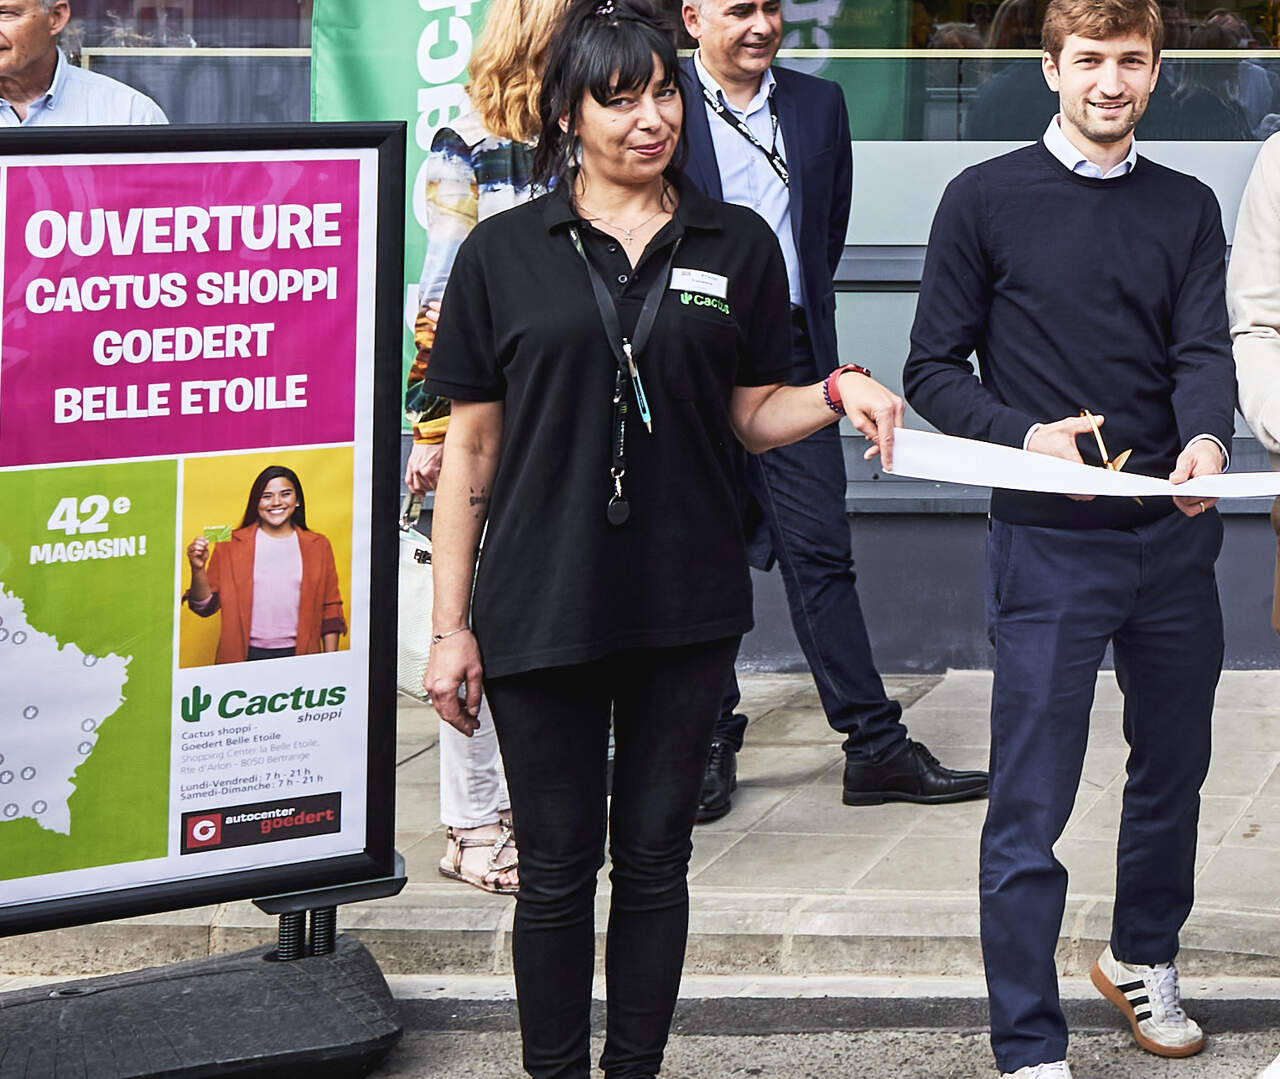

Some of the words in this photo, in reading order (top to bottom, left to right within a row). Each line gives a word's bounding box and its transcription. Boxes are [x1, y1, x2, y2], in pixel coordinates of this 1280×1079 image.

[24, 203, 342, 258] OUVERTURE
[25, 273, 187, 314] CACTUS
[197, 267, 338, 306] SHOPPI
[93, 323, 275, 366] GOEDERT
[54, 383, 170, 424] BELLE
[181, 374, 308, 415] ETOILE
[217, 686, 347, 719] Cactus
[297, 708, 343, 724] shoppi
[181, 741, 223, 752] Goedert
[226, 736, 250, 746] Belle
[253, 732, 281, 743] Etoile
[182, 729, 215, 740] Cactus
[217, 725, 252, 737] shoppi
[225, 807, 295, 824] autocenter
[260, 809, 335, 834] goedert
